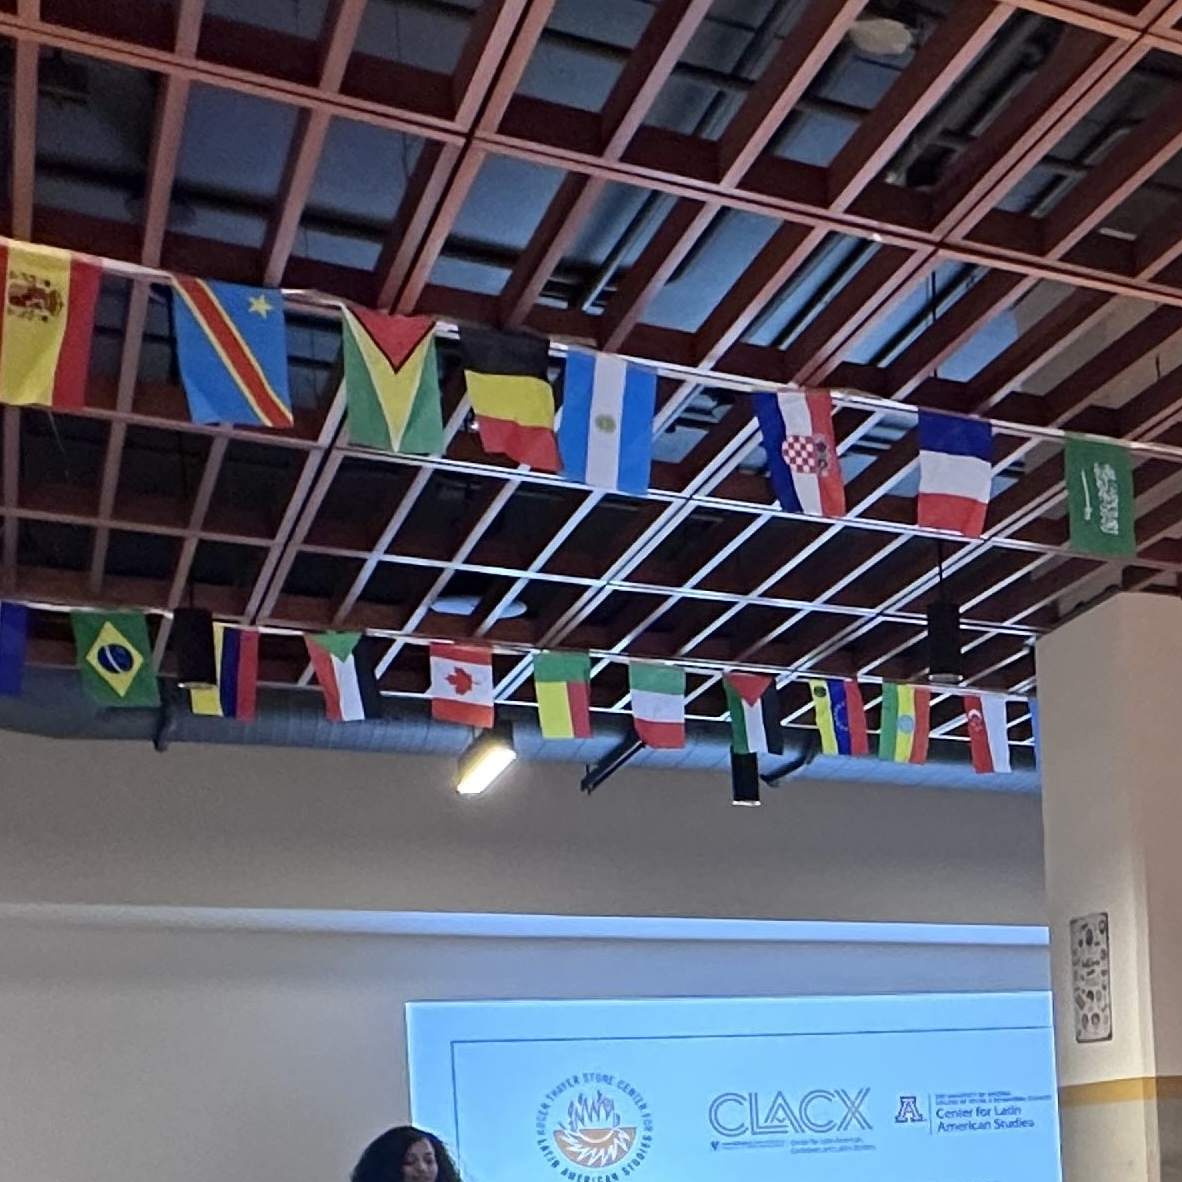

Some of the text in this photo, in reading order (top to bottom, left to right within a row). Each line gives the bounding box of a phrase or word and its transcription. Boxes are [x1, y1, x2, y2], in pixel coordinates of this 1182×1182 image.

[708, 1086, 874, 1139] CLACX
[936, 1104, 1022, 1120] Center for Latin
[937, 1117, 1035, 1133] American Studies
